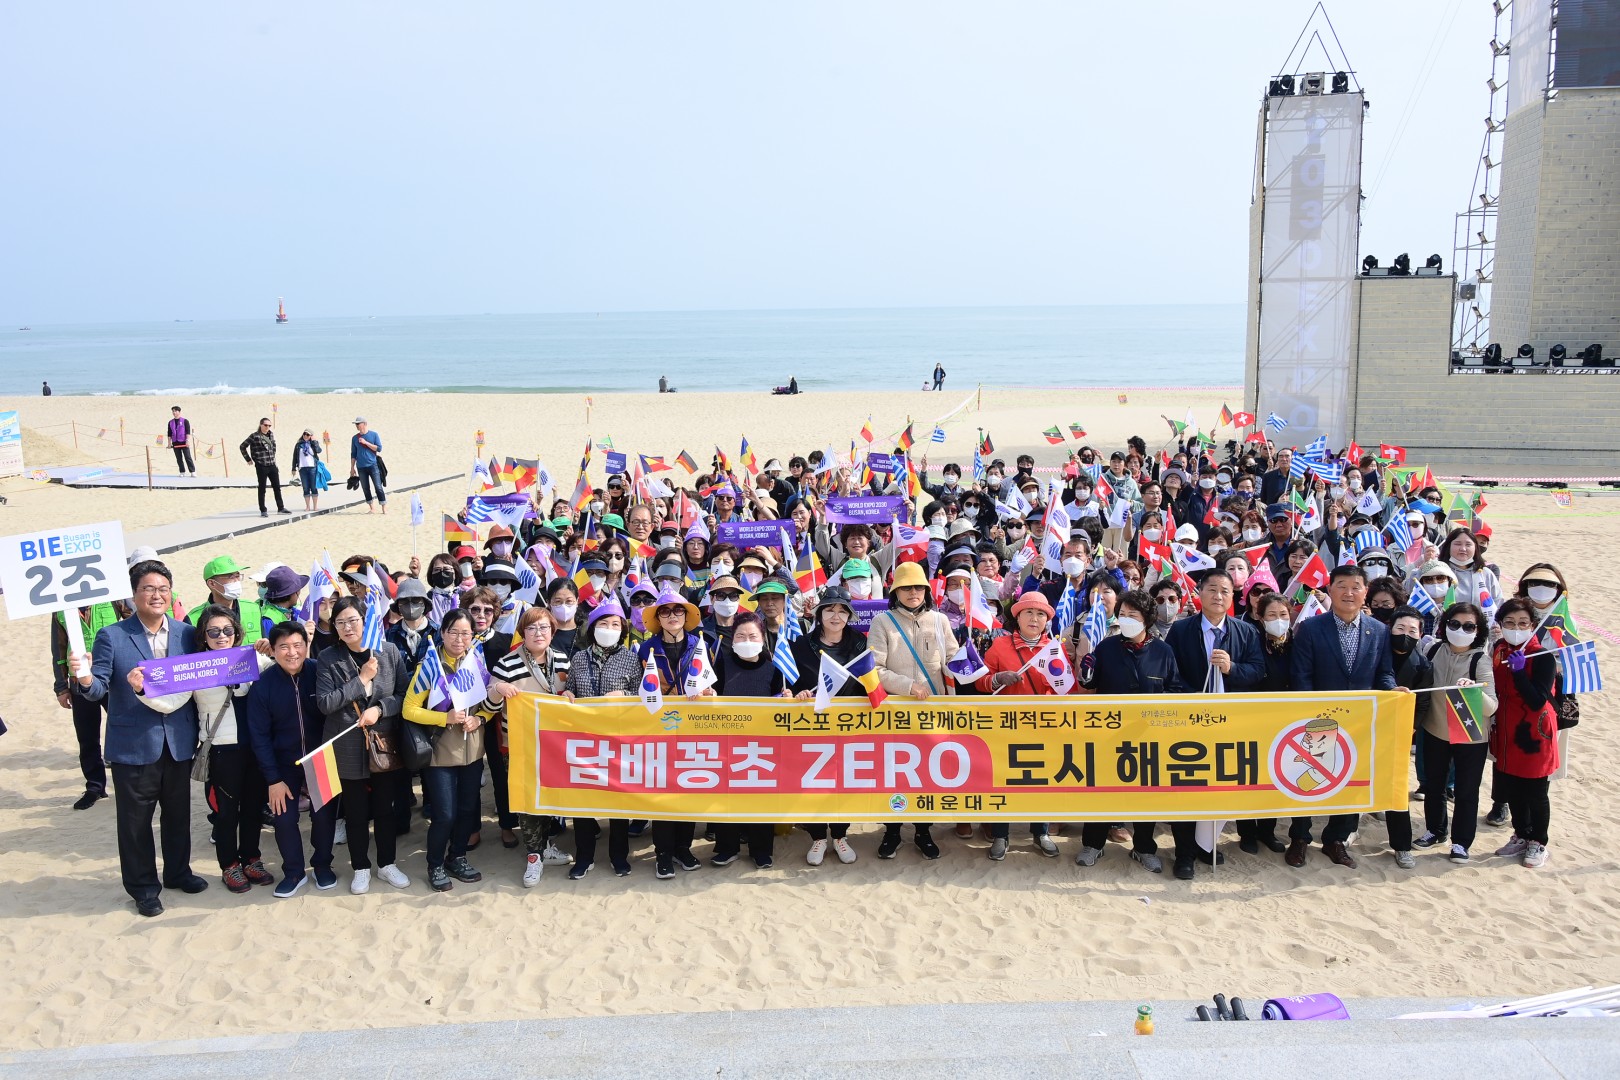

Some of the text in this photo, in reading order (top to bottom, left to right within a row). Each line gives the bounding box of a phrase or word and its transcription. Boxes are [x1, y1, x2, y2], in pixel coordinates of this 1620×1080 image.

[63, 530, 100, 543] Busan is
[20, 536, 63, 561] BIE
[64, 538, 102, 554] EXPO
[25, 554, 109, 606] 2조
[172, 657, 228, 673] WORLD EXPO 2030
[174, 668, 218, 682] BUSAN, KOREA
[694, 722, 719, 730] BUSAN,
[774, 711, 1121, 732] 엑스포 유치기원 함께하는 쾌적도시 조성
[566, 739, 1258, 789] 담배꽁초 ZERO 도시 해운대
